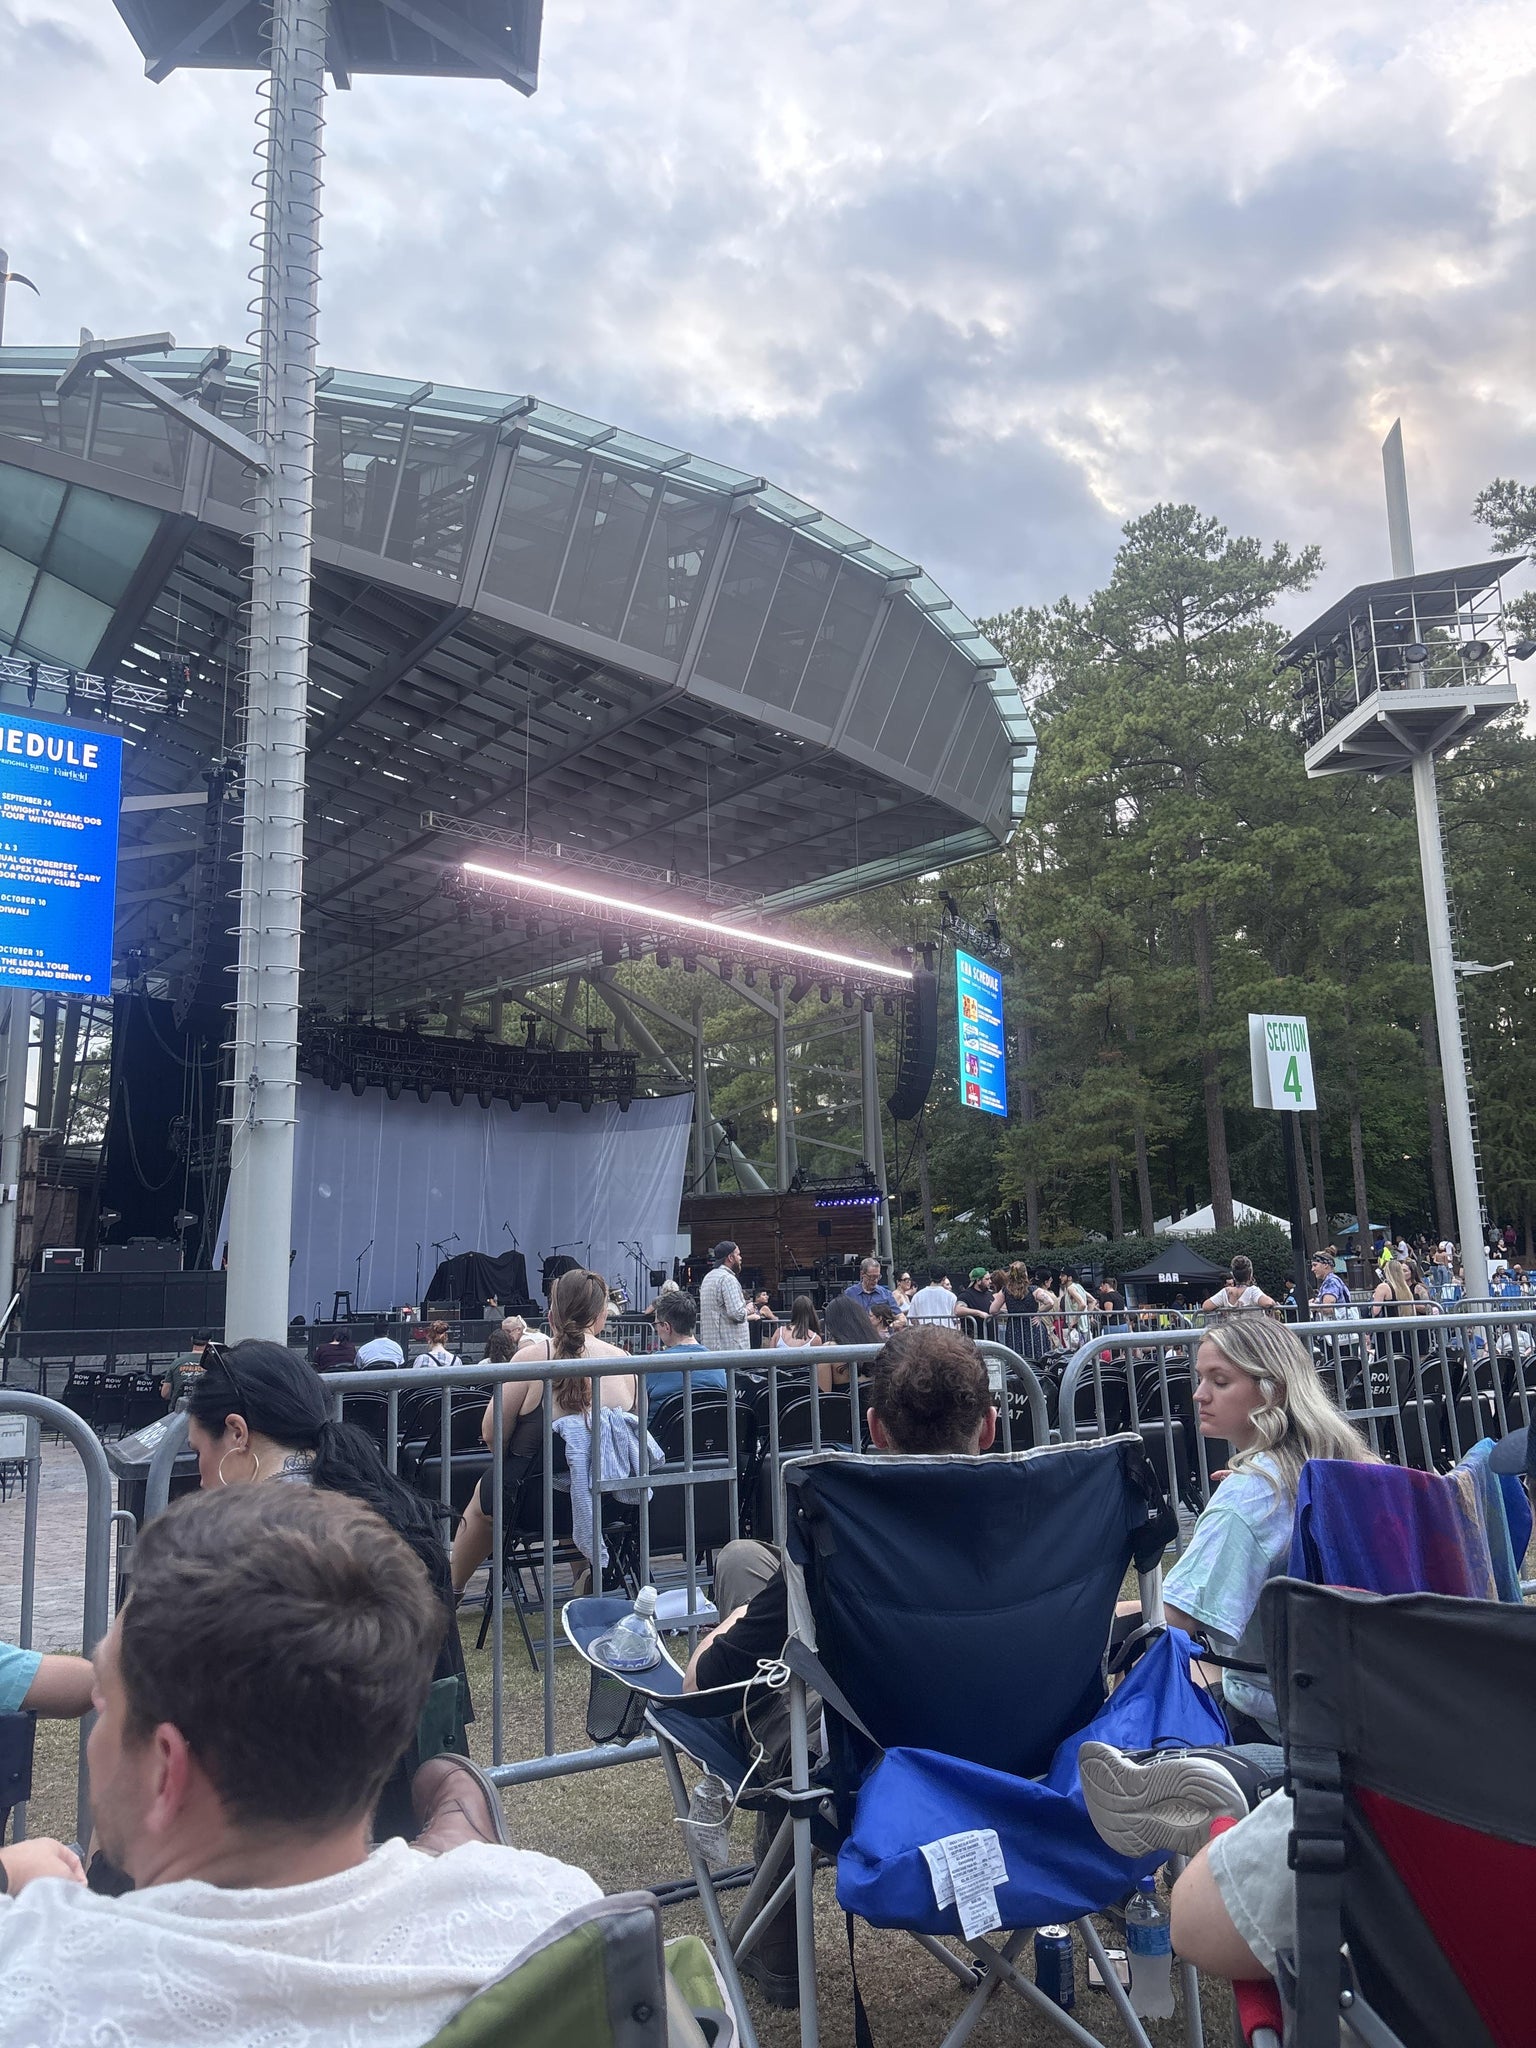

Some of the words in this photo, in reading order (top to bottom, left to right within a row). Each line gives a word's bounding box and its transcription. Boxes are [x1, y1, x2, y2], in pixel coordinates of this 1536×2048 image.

[0, 727, 98, 768] EDULE
[1, 792, 42, 805] SEPTEMBER
[43, 799, 52, 807] 24
[1, 810, 25, 821] TOUR
[28, 814, 52, 825] WITH
[53, 818, 84, 830] WESKO
[3, 803, 41, 815] DWIGHT
[83, 816, 102, 826] DOS
[19, 857, 78, 871] OKTOBERFEST
[9, 863, 32, 873] APEX
[33, 867, 69, 878] SUNRISE
[77, 873, 102, 883] CARY
[17, 873, 52, 884] ROTARY
[53, 878, 81, 888] CLUBS
[0, 893, 36, 905] OCTOBER
[38, 898, 47, 907] 10
[0, 945, 33, 956] OCTOBER
[35, 949, 44, 957] 15
[1, 957, 18, 966] THE
[18, 959, 45, 969] LEGAL
[46, 962, 69, 971] TOUR
[8, 967, 34, 976] COBB
[34, 969, 54, 978] AND
[54, 971, 83, 981] BENNY
[972, 966, 999, 992] SCHEDULE
[1266, 1022, 1307, 1052] SECTION
[1283, 1056, 1302, 1102] 4
[1158, 1273, 1180, 1283] BAR
